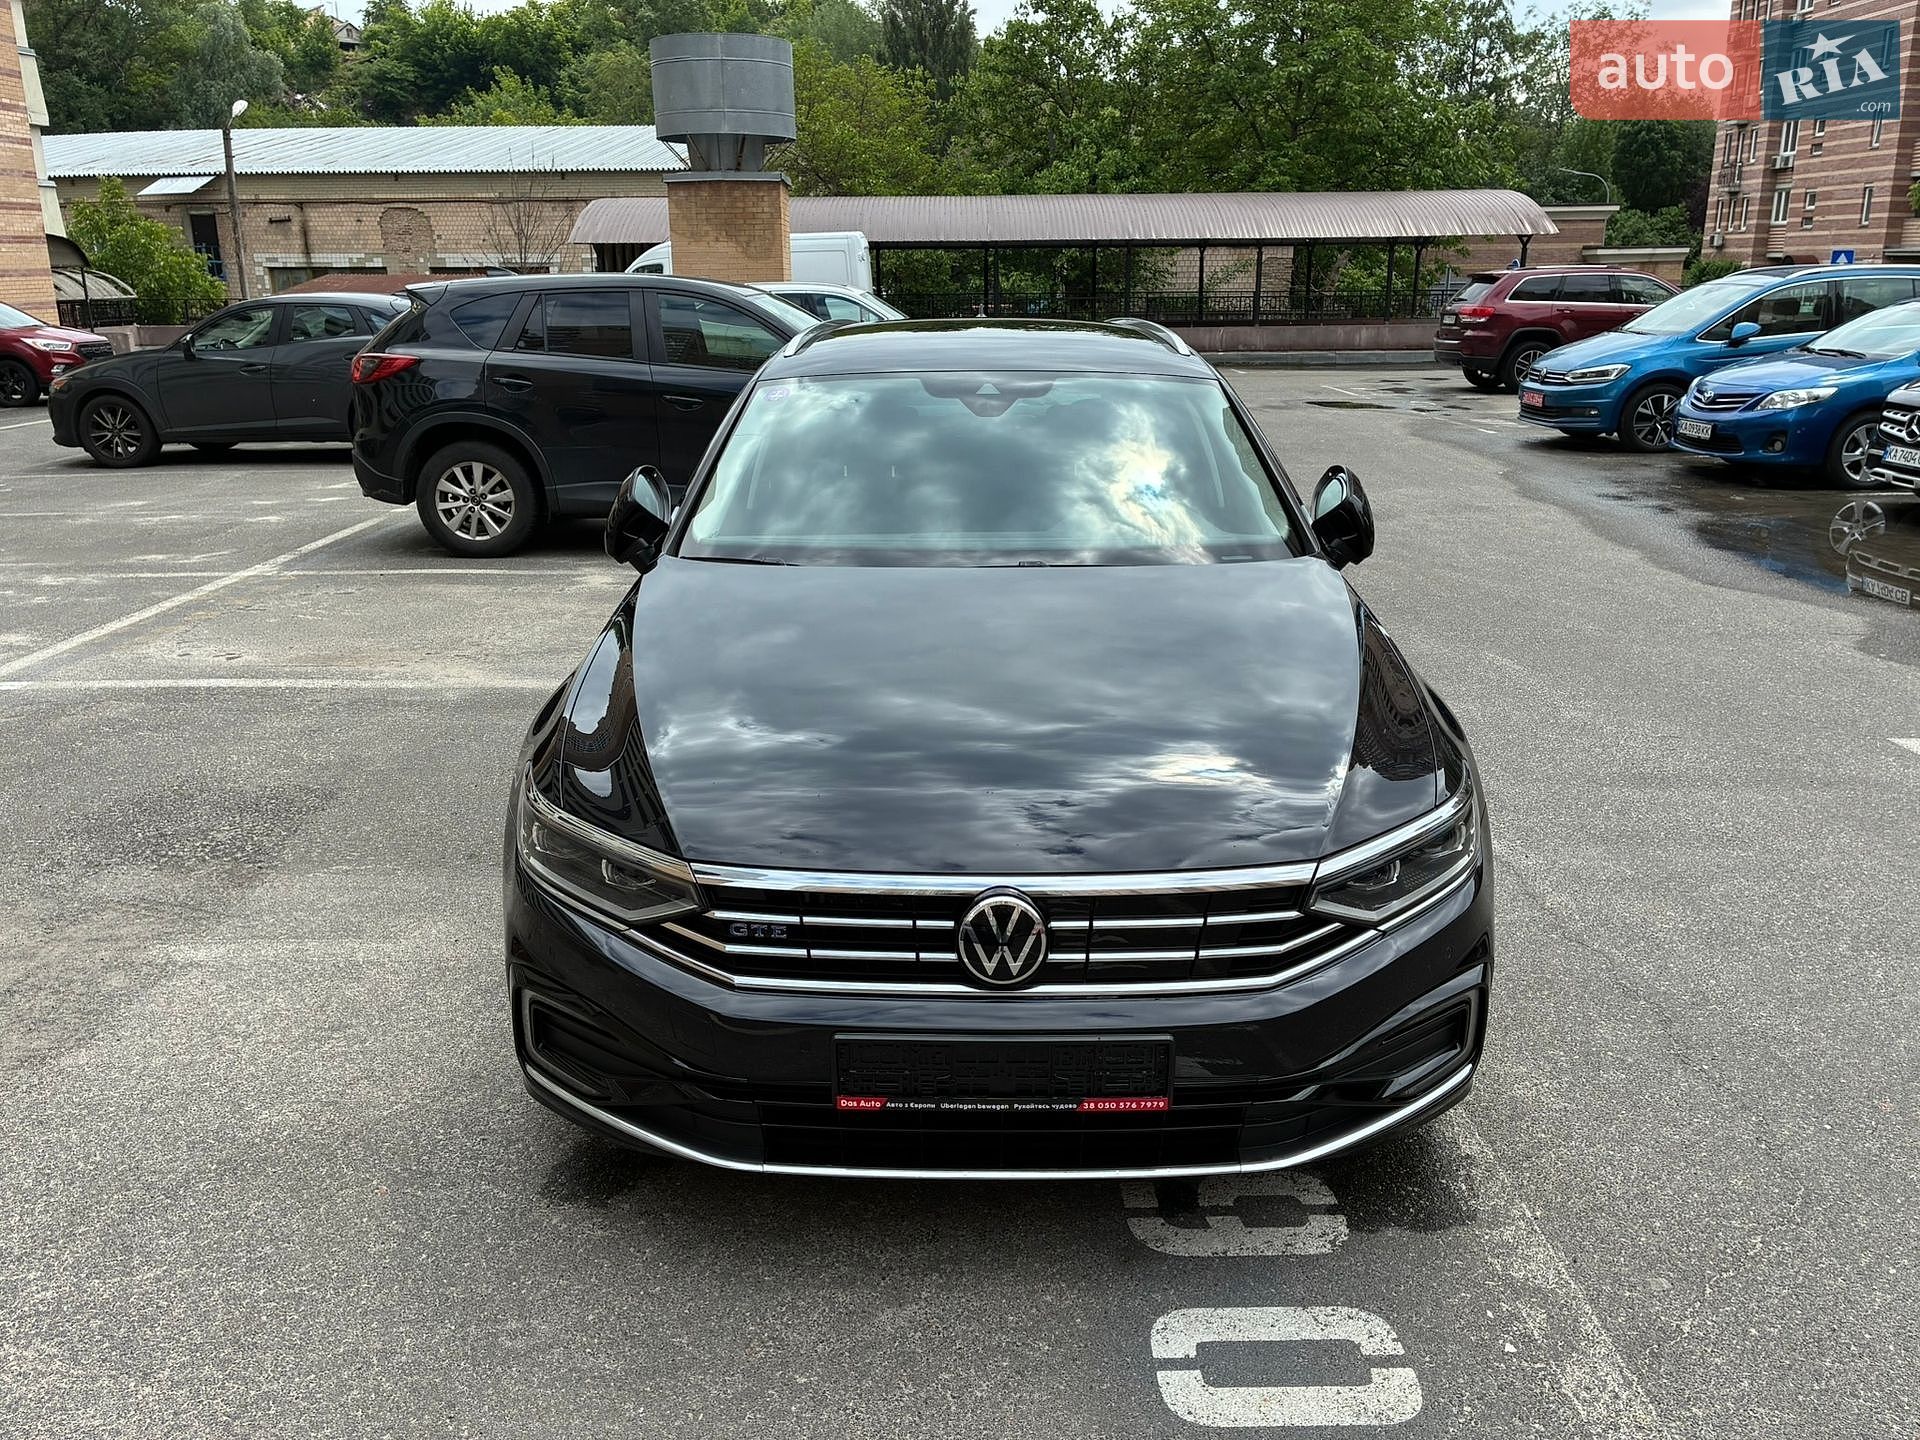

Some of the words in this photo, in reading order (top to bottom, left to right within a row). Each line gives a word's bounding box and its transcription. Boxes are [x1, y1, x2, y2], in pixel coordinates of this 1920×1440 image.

[729, 922, 787, 939] GTE
[840, 1099, 858, 1107] Das
[859, 1100, 881, 1108] Auto
[1140, 1101, 1165, 1109] 7979
